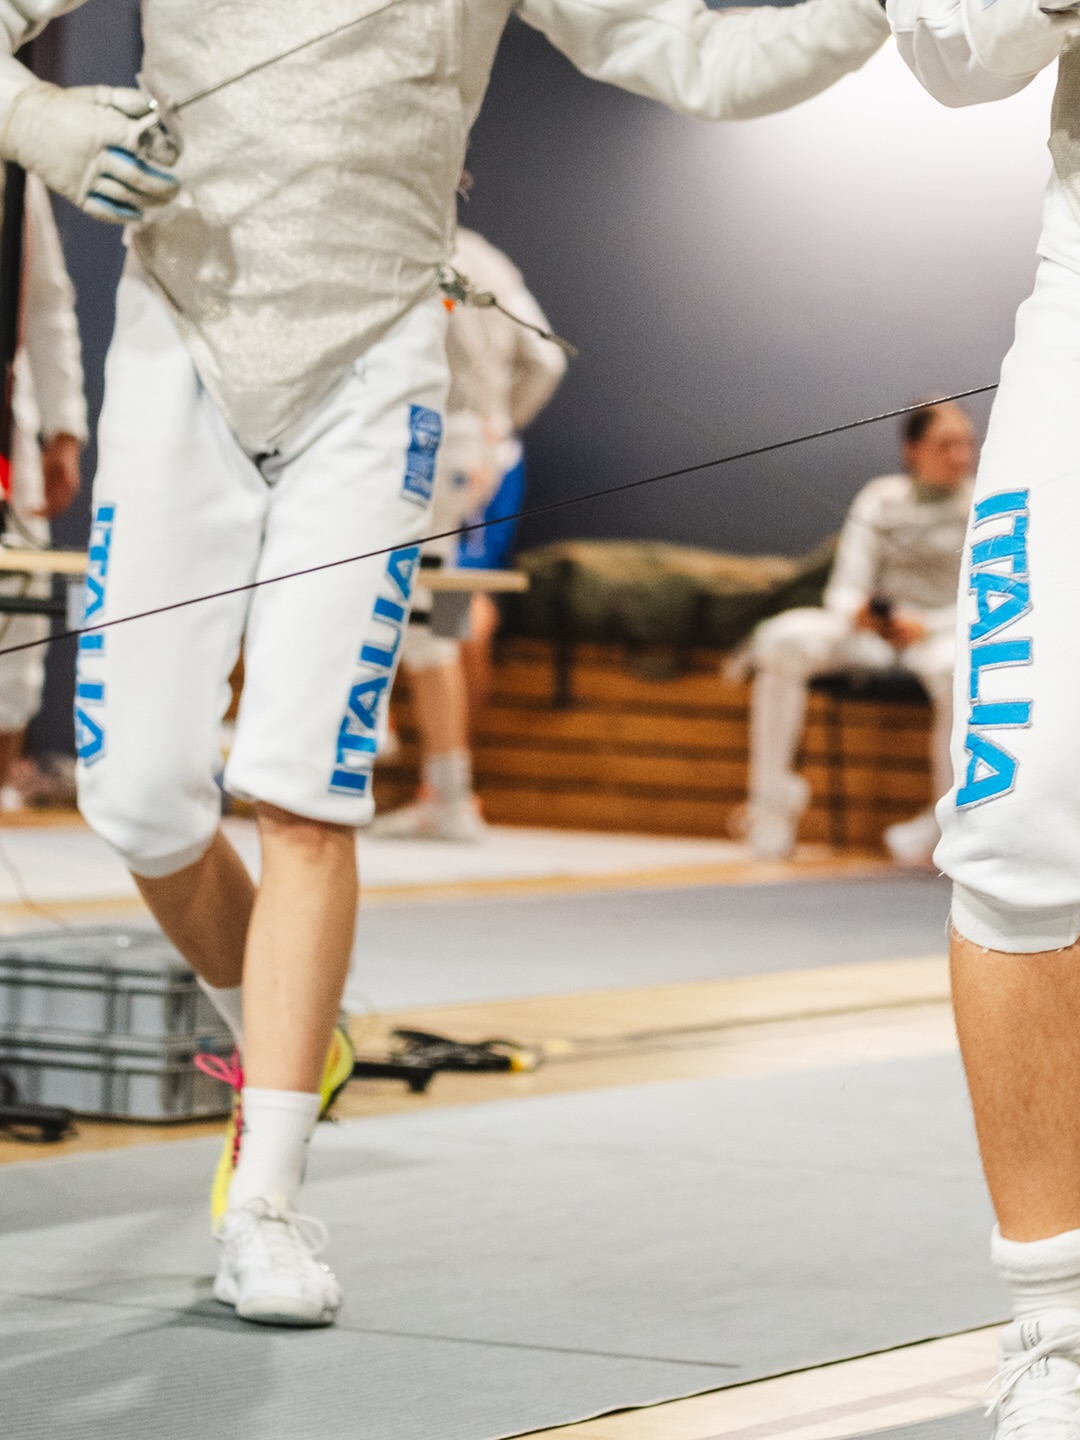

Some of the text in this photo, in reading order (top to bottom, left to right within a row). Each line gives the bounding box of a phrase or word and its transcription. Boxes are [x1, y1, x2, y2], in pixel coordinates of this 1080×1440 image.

[74, 502, 117, 768] ITALIA
[329, 545, 421, 797] ITALIA
[955, 487, 1034, 811] ITALIA
